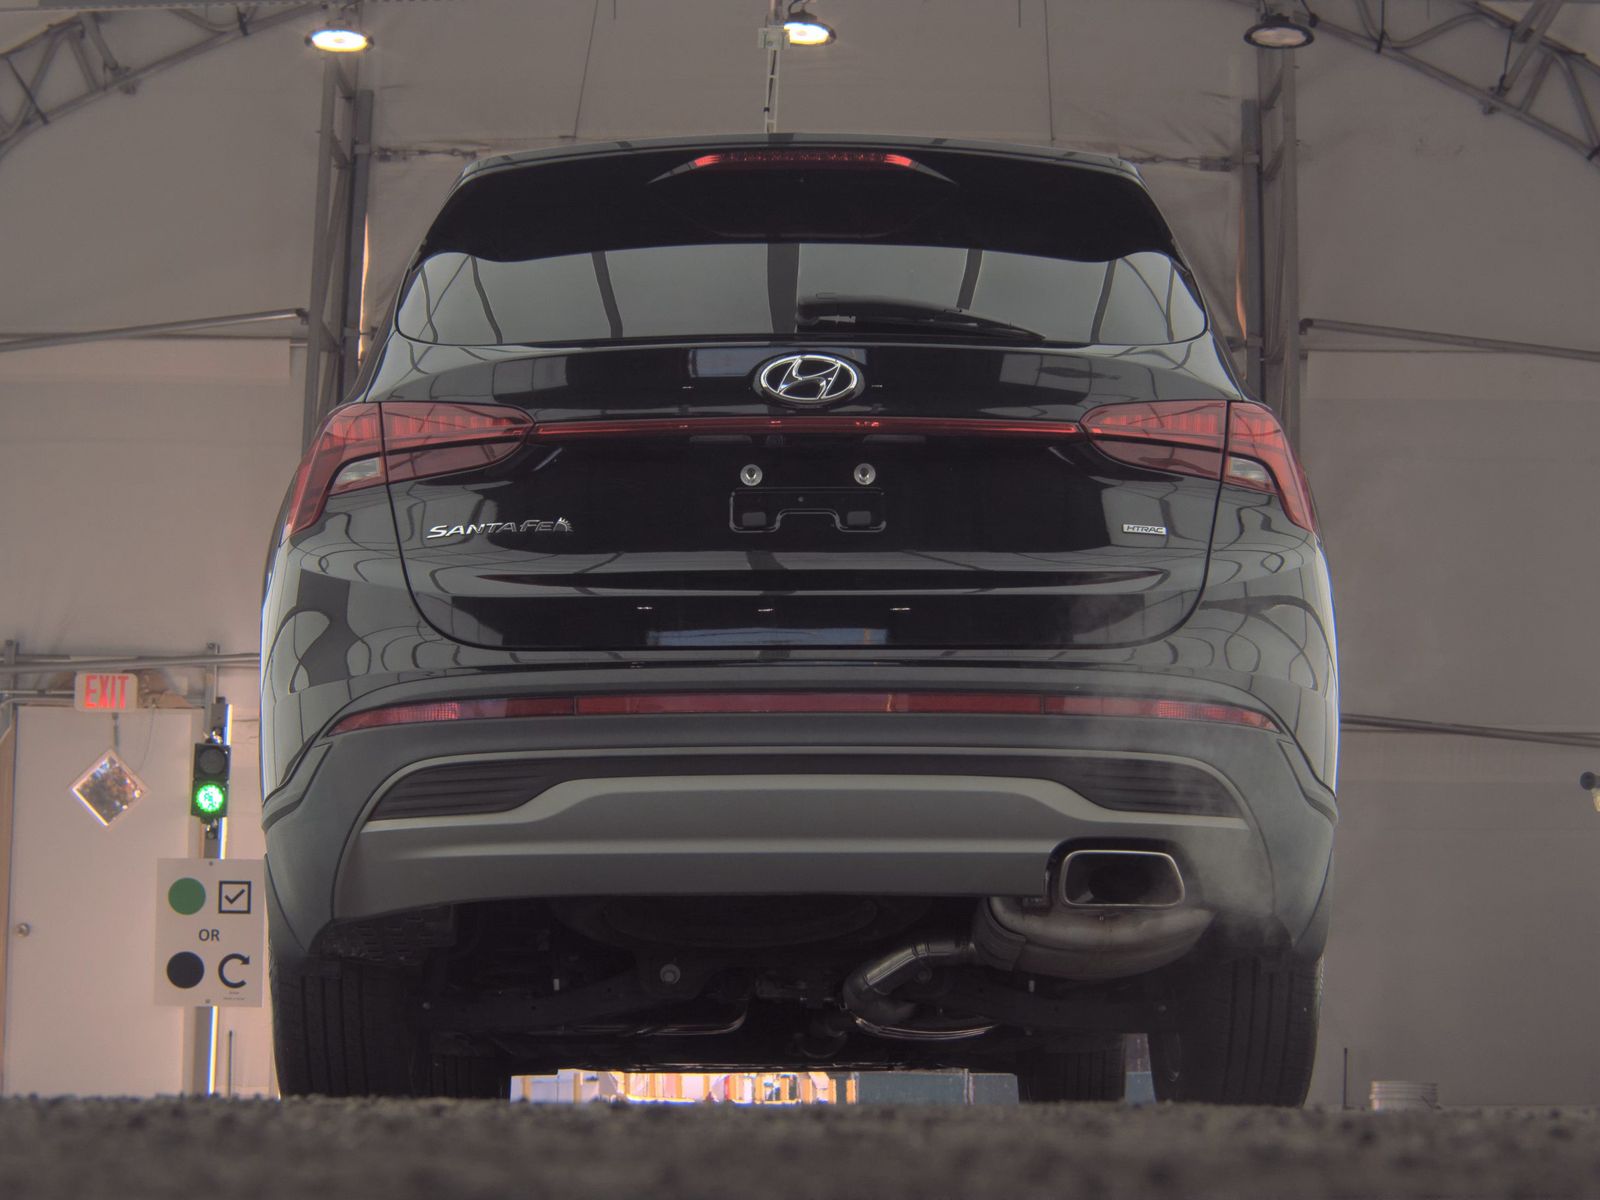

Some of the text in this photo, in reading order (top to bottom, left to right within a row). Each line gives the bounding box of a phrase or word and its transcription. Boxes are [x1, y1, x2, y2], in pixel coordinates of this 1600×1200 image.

[1125, 525, 1164, 534] HTRAC
[84, 674, 129, 709] EXIT
[198, 928, 220, 942] OR
